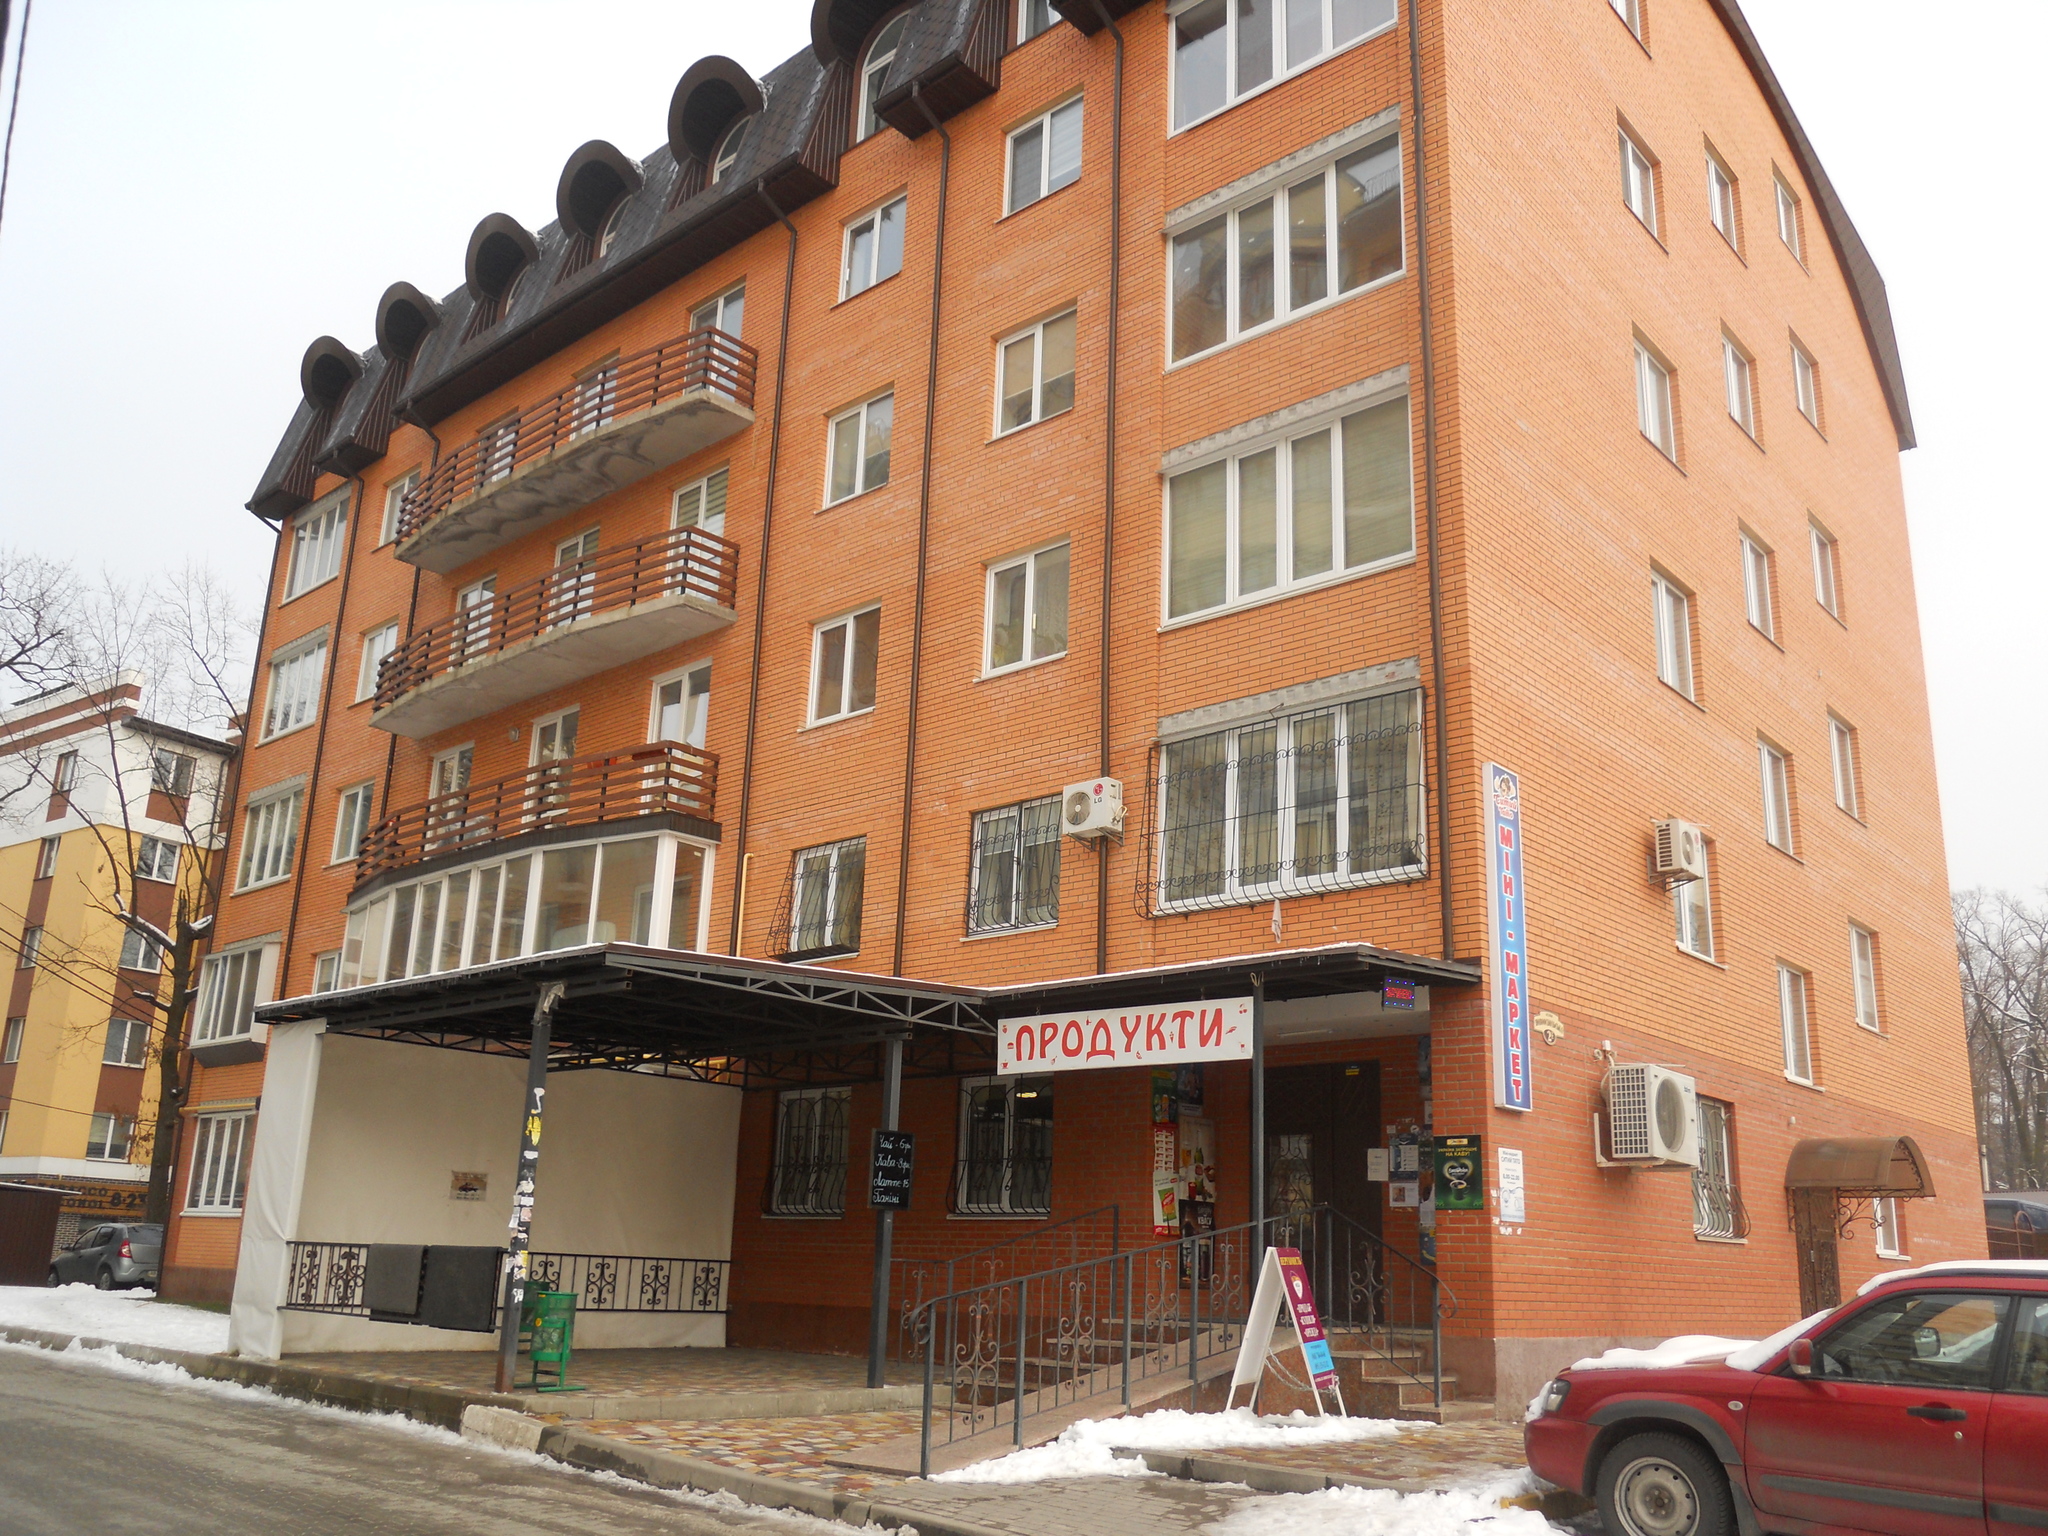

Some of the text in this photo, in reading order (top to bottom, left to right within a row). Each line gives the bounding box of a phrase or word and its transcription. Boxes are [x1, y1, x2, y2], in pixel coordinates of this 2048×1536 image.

[1093, 796, 1103, 804] LG
[1015, 1007, 1223, 1062] ПРОДУКТИ
[880, 1135, 894, 1149] Чай
